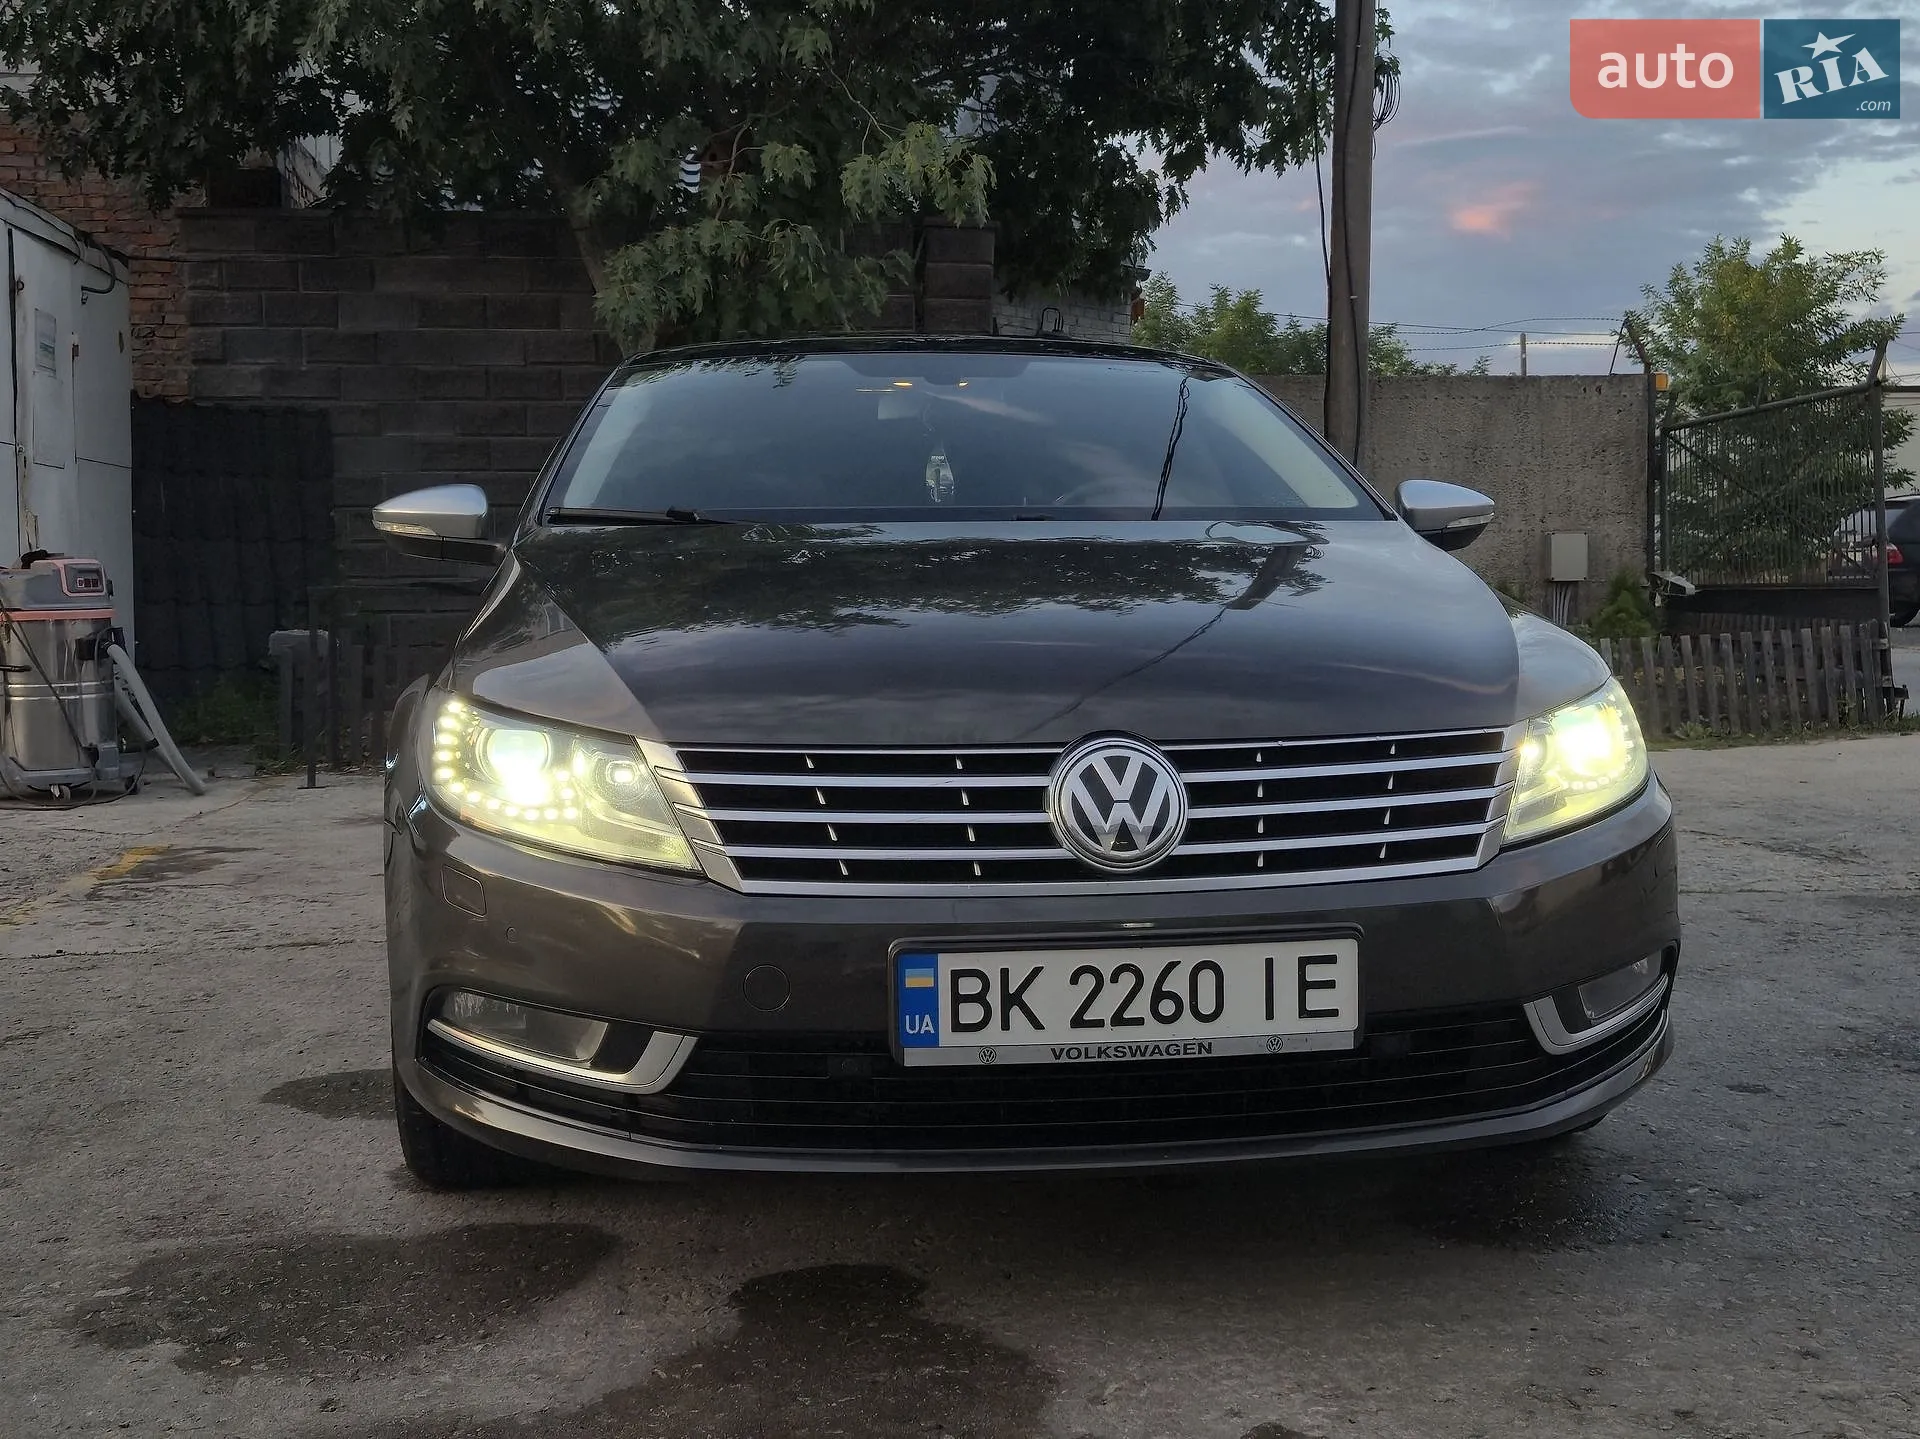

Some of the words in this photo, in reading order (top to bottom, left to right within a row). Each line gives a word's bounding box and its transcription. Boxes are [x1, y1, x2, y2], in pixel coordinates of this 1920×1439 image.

[949, 965, 1046, 1033] BK
[1069, 959, 1225, 1029] 2260
[1264, 954, 1340, 1021] IE
[905, 1014, 935, 1034] UA
[1050, 1041, 1213, 1061] VOLKSWAGEN
